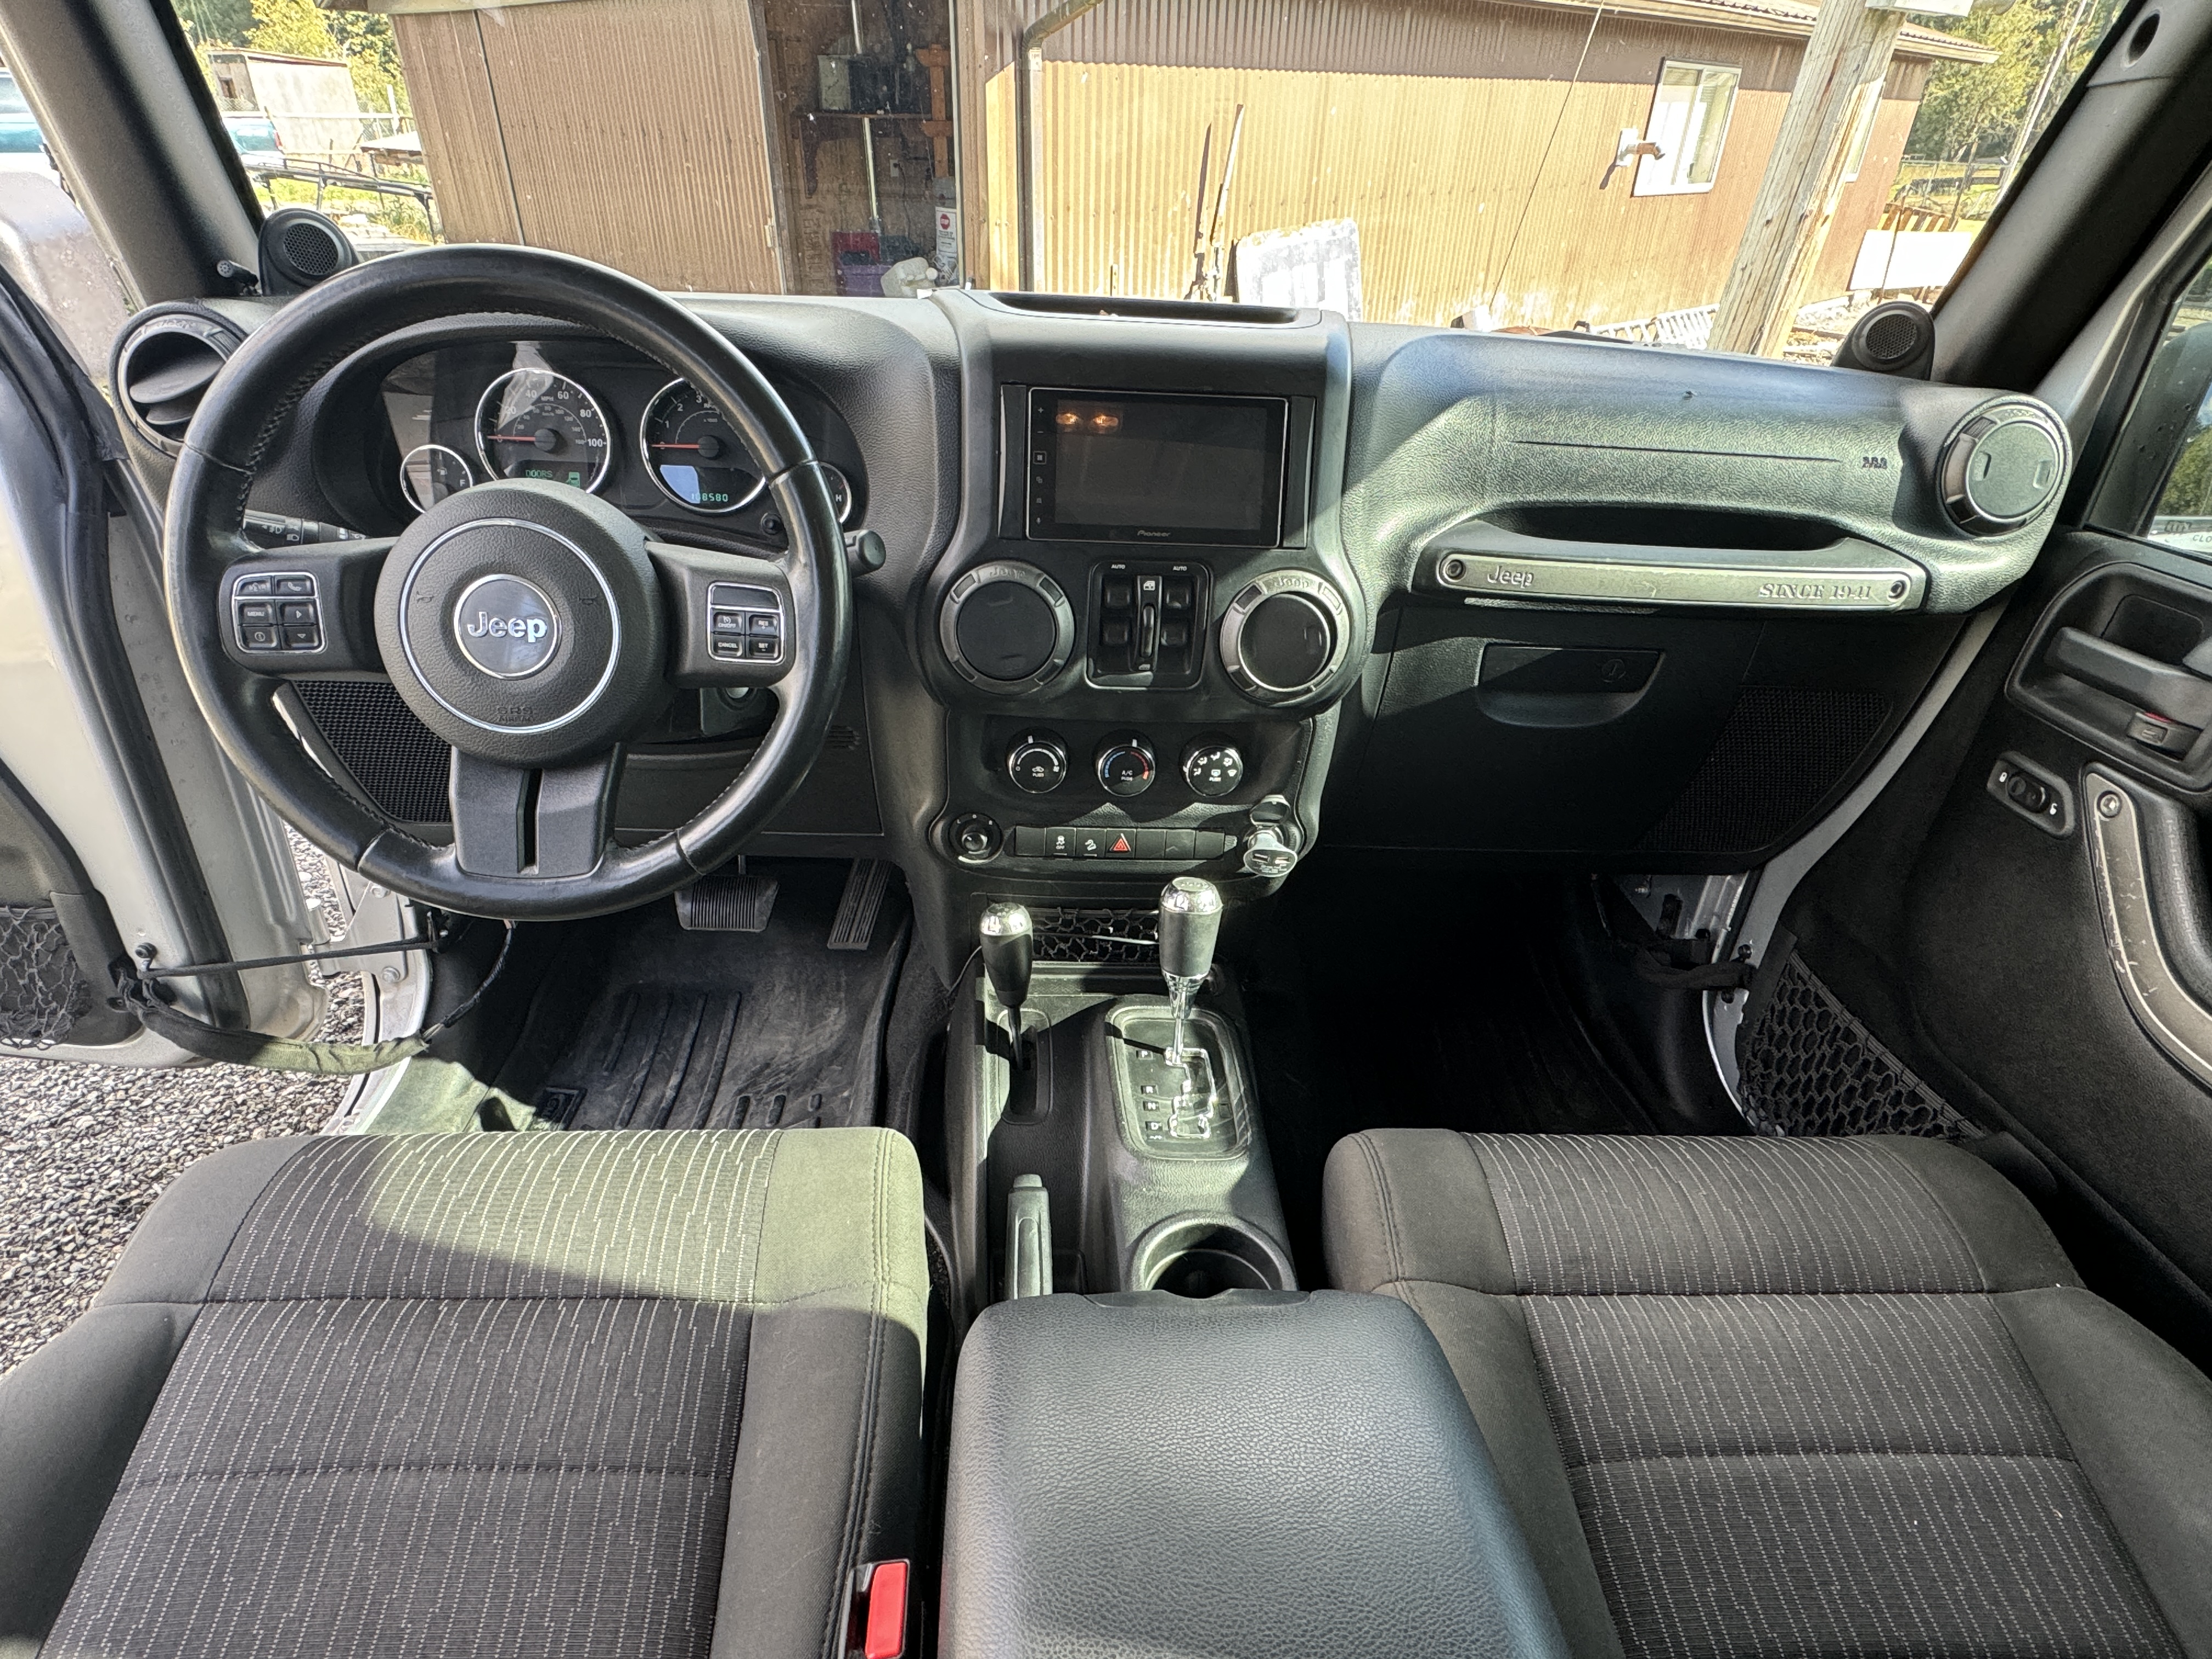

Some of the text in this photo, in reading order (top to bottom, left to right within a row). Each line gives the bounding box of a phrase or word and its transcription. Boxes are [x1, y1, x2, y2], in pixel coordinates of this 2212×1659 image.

[525, 390, 537, 398] 40
[557, 391, 569, 400] 60
[696, 394, 702, 404] 3
[505, 406, 517, 415] 20
[677, 403, 683, 411] 2
[579, 409, 592, 418] 80
[587, 438, 603, 448] 100
[526, 469, 553, 478] DOORS
[460, 479, 465, 487] F
[836, 494, 842, 502] H
[1487, 565, 1535, 589] Jeep
[1758, 583, 1872, 600] SINCE 1941
[467, 611, 548, 643] Jeep
